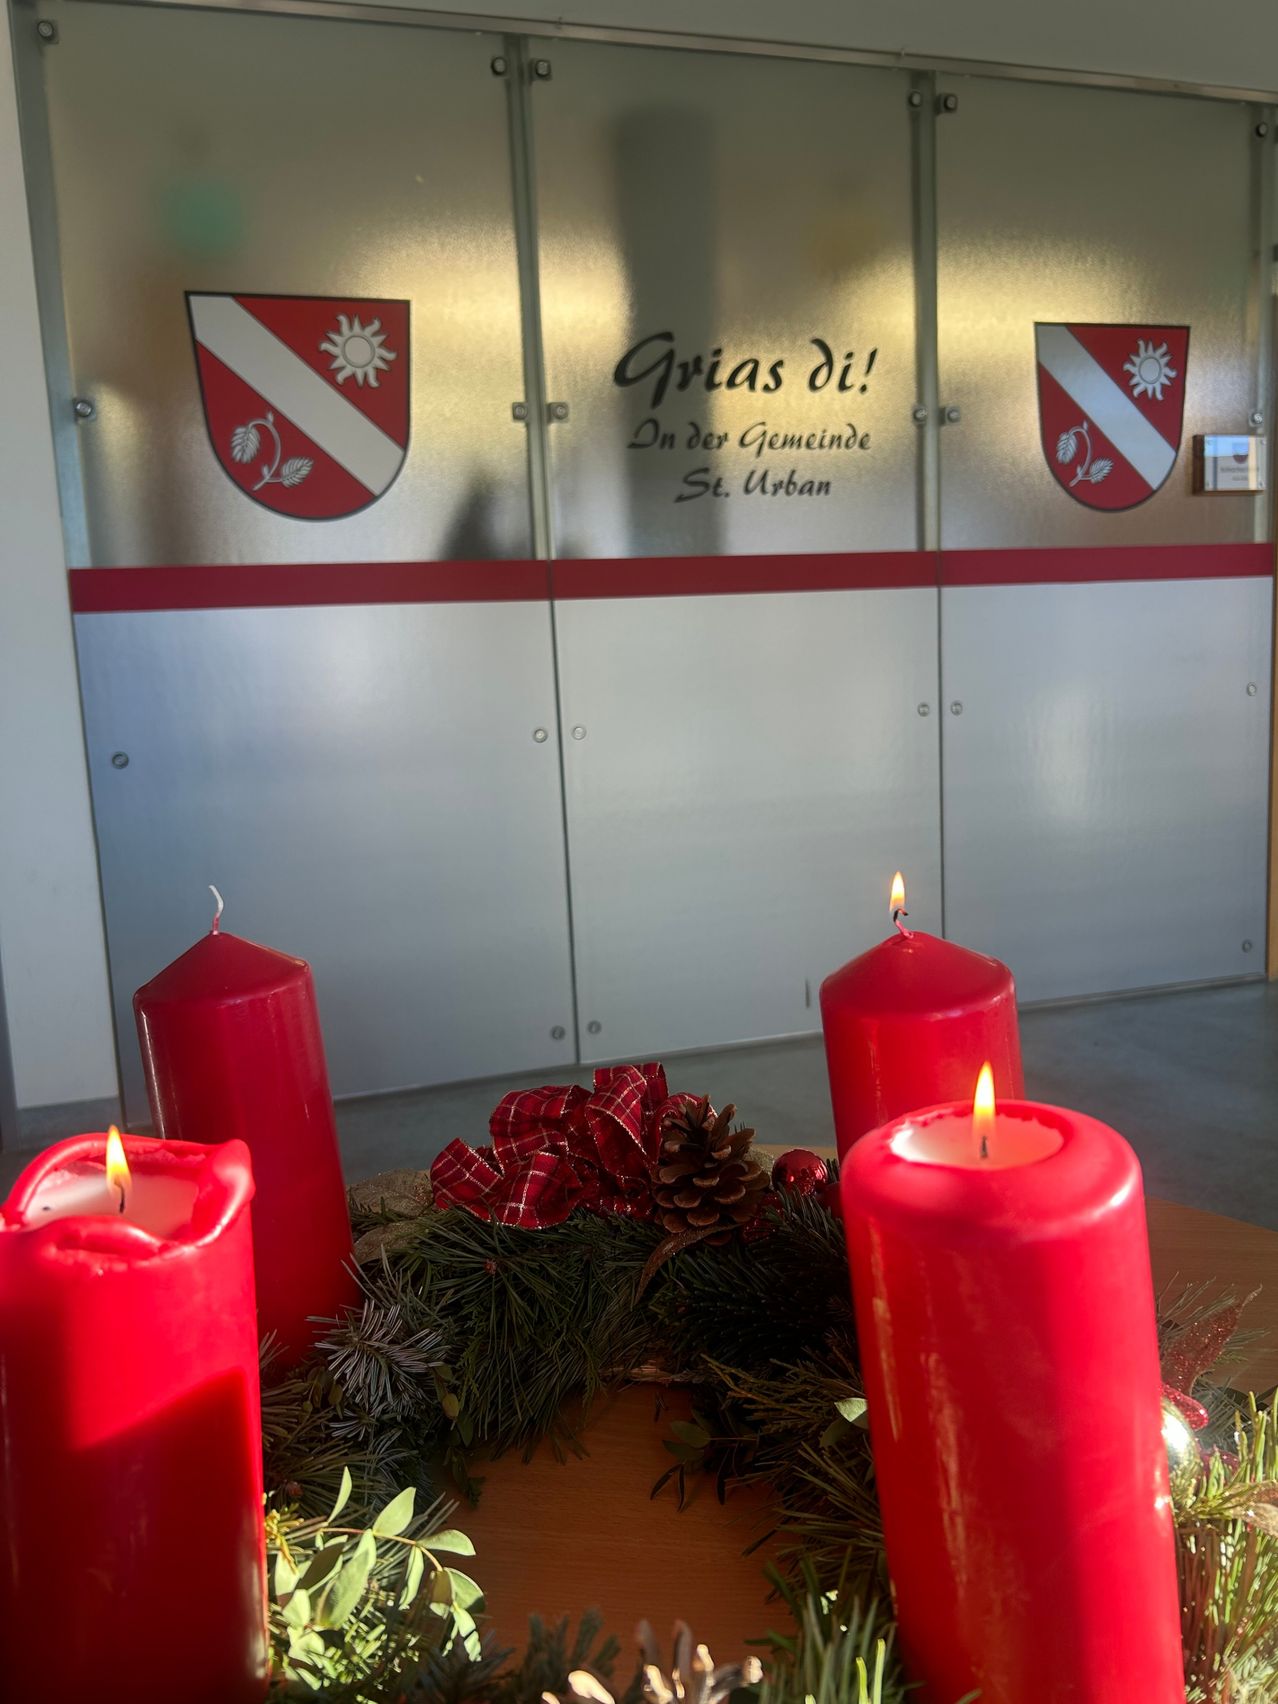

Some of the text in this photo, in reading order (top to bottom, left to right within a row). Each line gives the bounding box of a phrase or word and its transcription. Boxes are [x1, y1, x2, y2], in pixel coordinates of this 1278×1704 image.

[613, 331, 878, 409] Grias di!
[627, 418, 872, 458] In der Gemeinde
[674, 467, 832, 503] St. Urban
